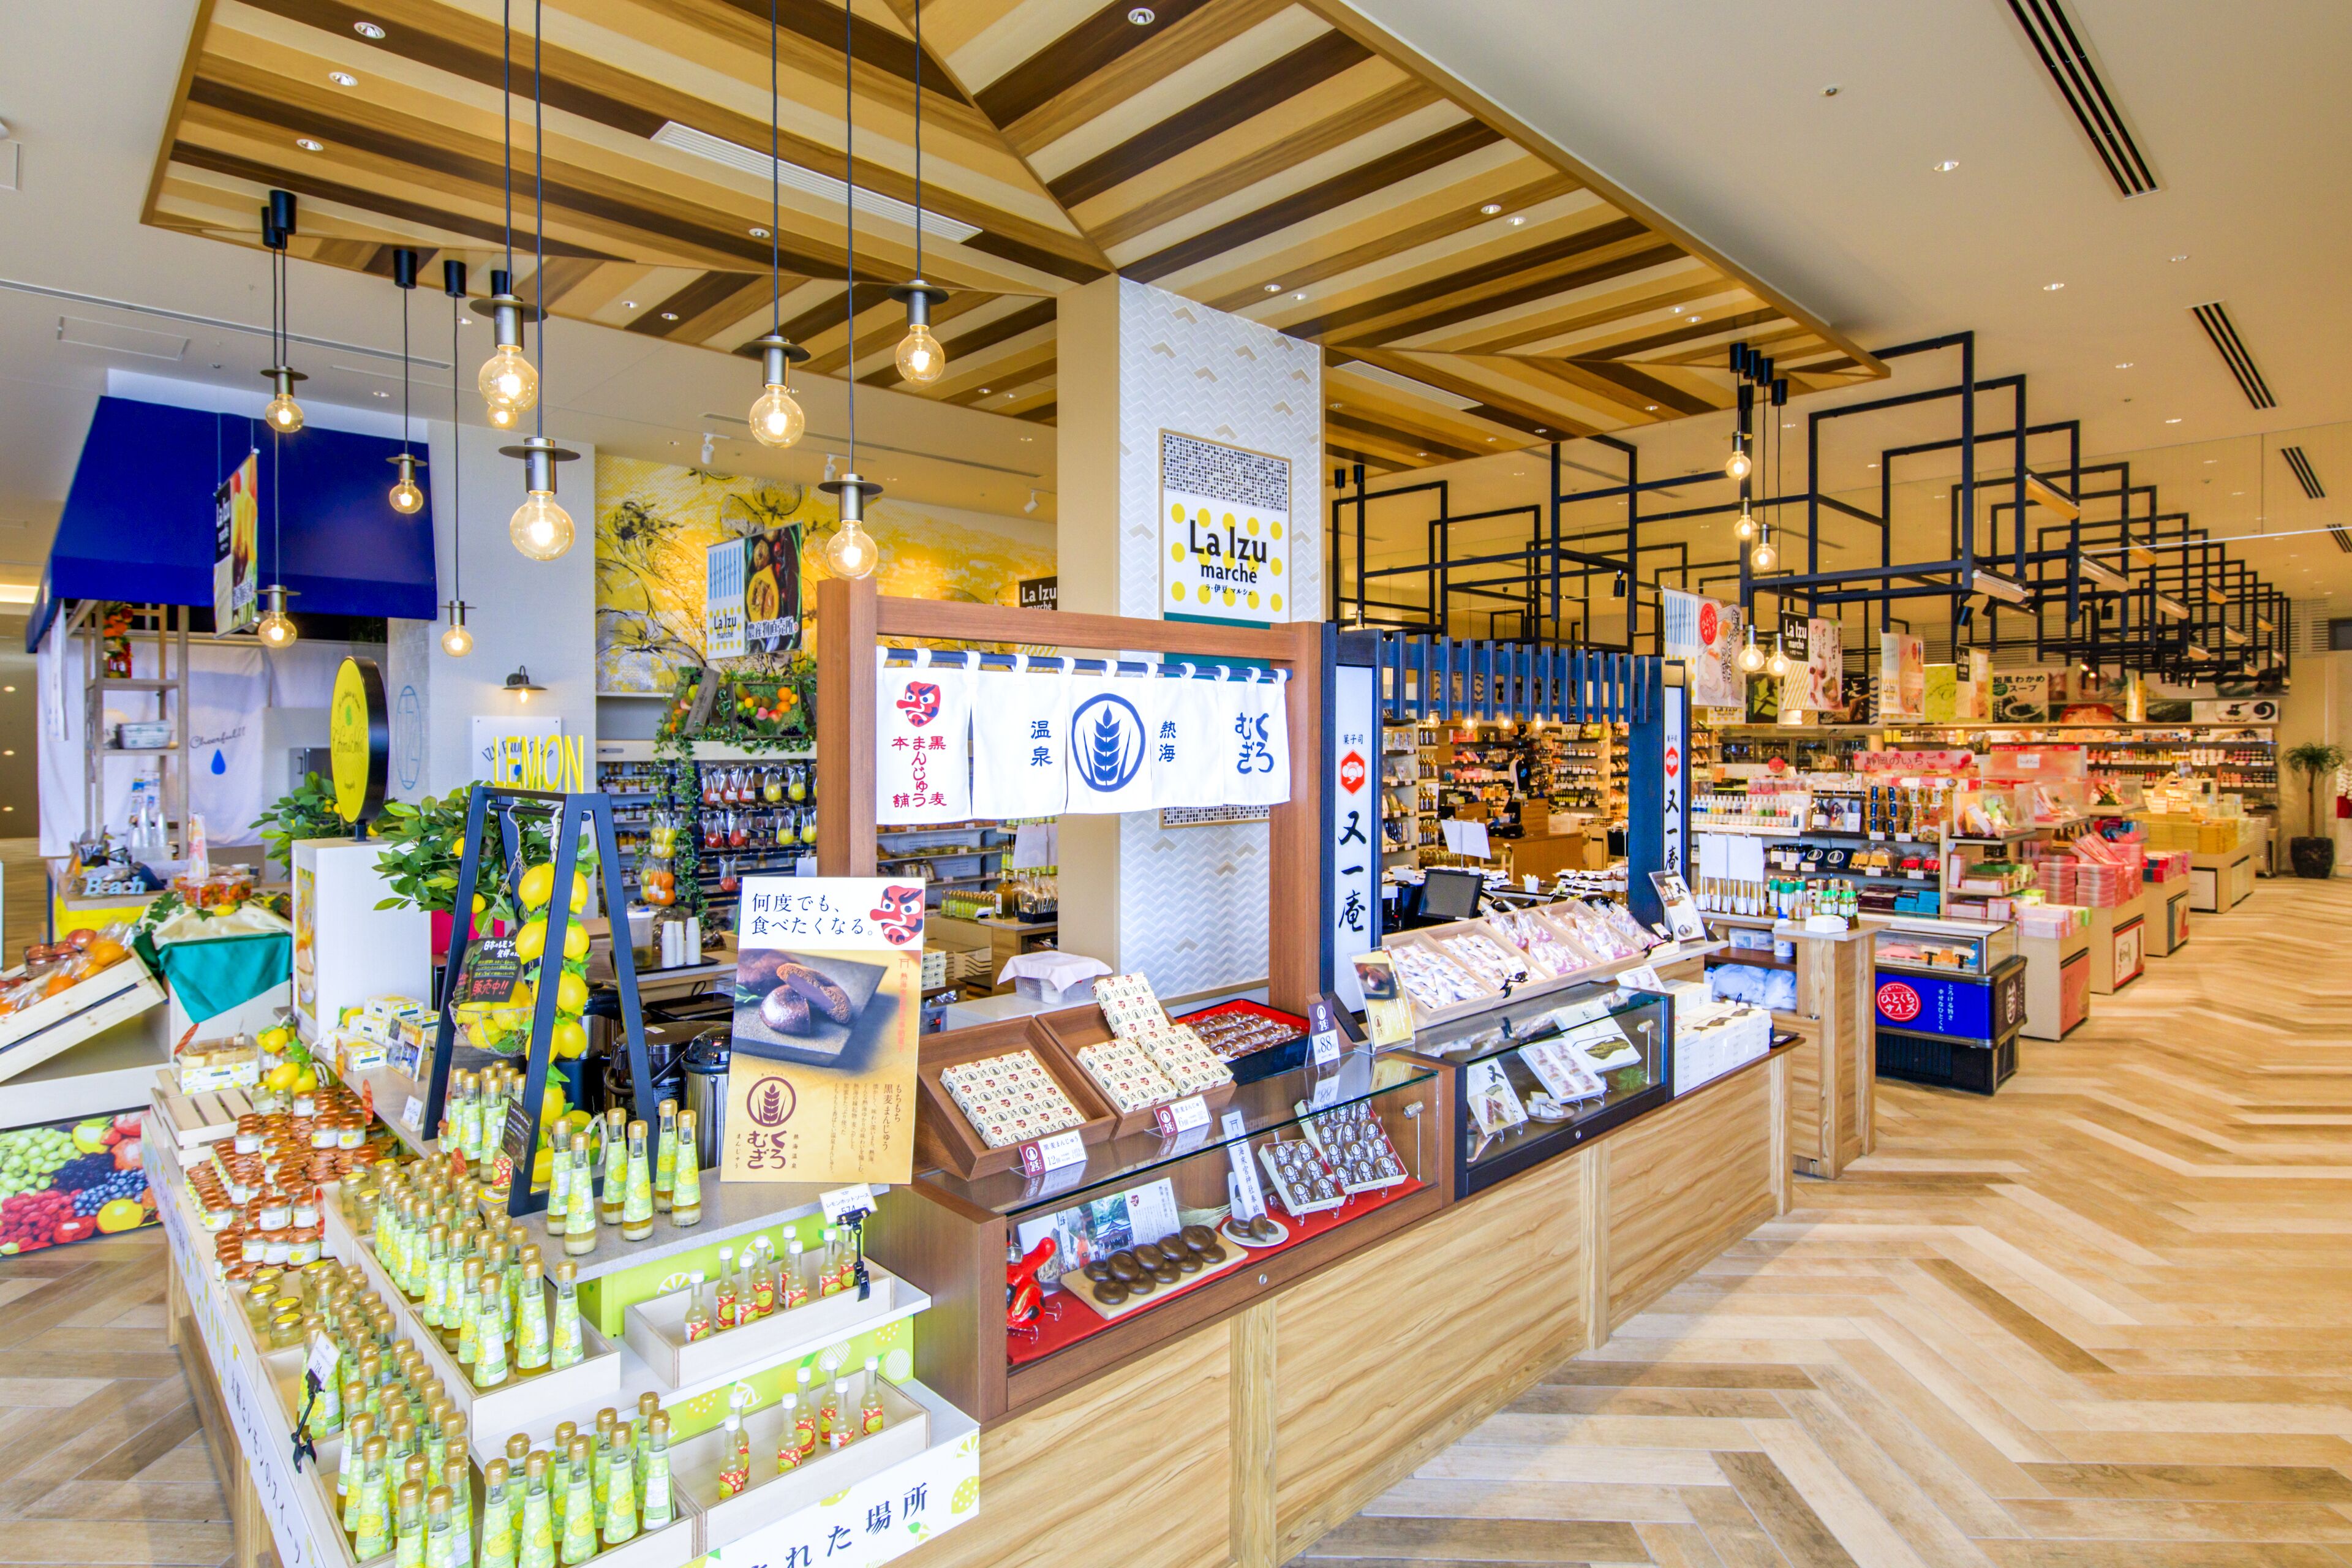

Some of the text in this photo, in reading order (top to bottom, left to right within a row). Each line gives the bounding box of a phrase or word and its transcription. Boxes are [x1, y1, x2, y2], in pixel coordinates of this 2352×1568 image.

[1189, 519, 1267, 564] La Izu
[1200, 564, 1257, 584] marché
[1022, 584, 1057, 603] La Izu
[714, 614, 737, 630] La Izu
[1785, 619, 1807, 639] La Izu
[1030, 720, 1053, 766] 温泉
[1159, 720, 1177, 763] 熱海
[1343, 734, 1363, 745] 菓子司
[494, 734, 584, 794] LEMON
[1866, 755, 1937, 766] 静岡のいちご
[910, 736, 927, 807] まんじゅう
[1664, 789, 1679, 871] 又一庵
[1338, 810, 1366, 932] 又一庵
[83, 876, 146, 897] Beach
[752, 892, 840, 914] 何度でも、
[750, 916, 874, 937] 食べたくなる。
[1881, 993, 1915, 1003] ひとくち
[1885, 1003, 1916, 1013] サイズ
[1320, 1035, 1332, 1053] 88
[883, 1084, 893, 1151] 黒麦まんじゅう
[1043, 1136, 1079, 1151] 黒麦まんじゅう
[826, 1193, 870, 1208] レモンホットソース
[751, 1482, 927, 1568] れた場所
